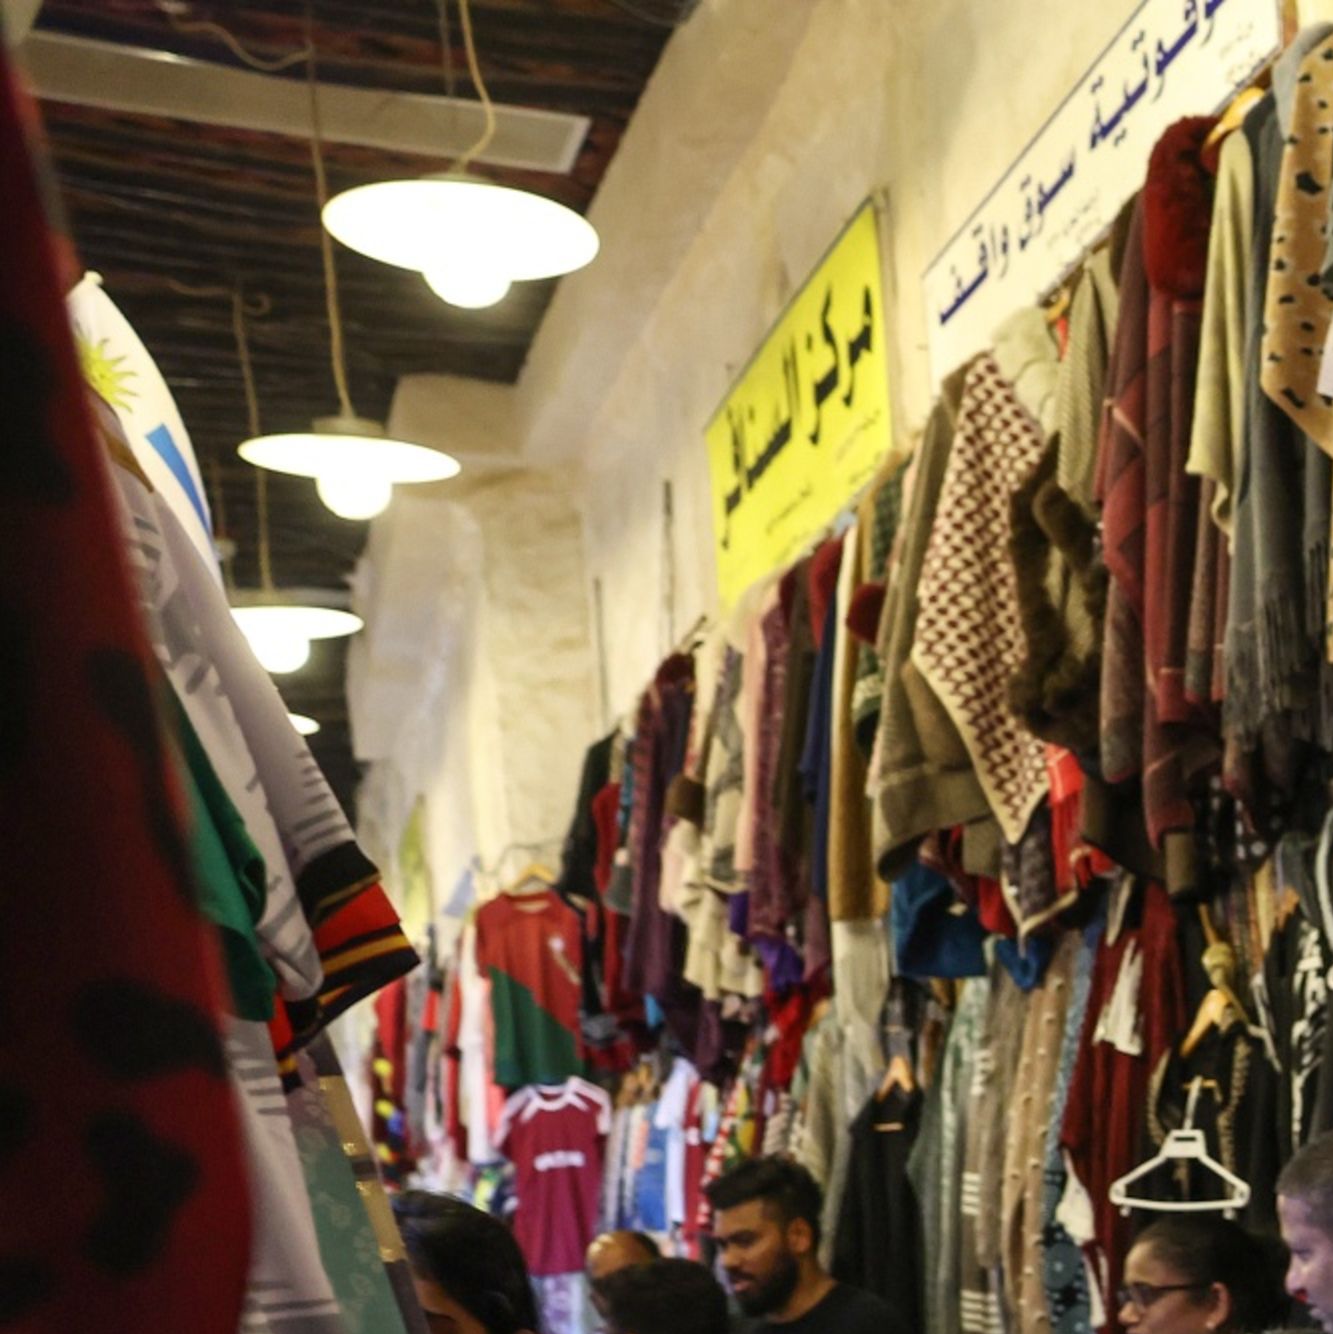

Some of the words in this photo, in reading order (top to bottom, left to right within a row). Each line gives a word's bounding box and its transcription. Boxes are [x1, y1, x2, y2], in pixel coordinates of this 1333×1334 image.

[1019, 147, 1076, 251] سوق
[940, 222, 1010, 326] واقف
[808, 281, 873, 446] مركز
